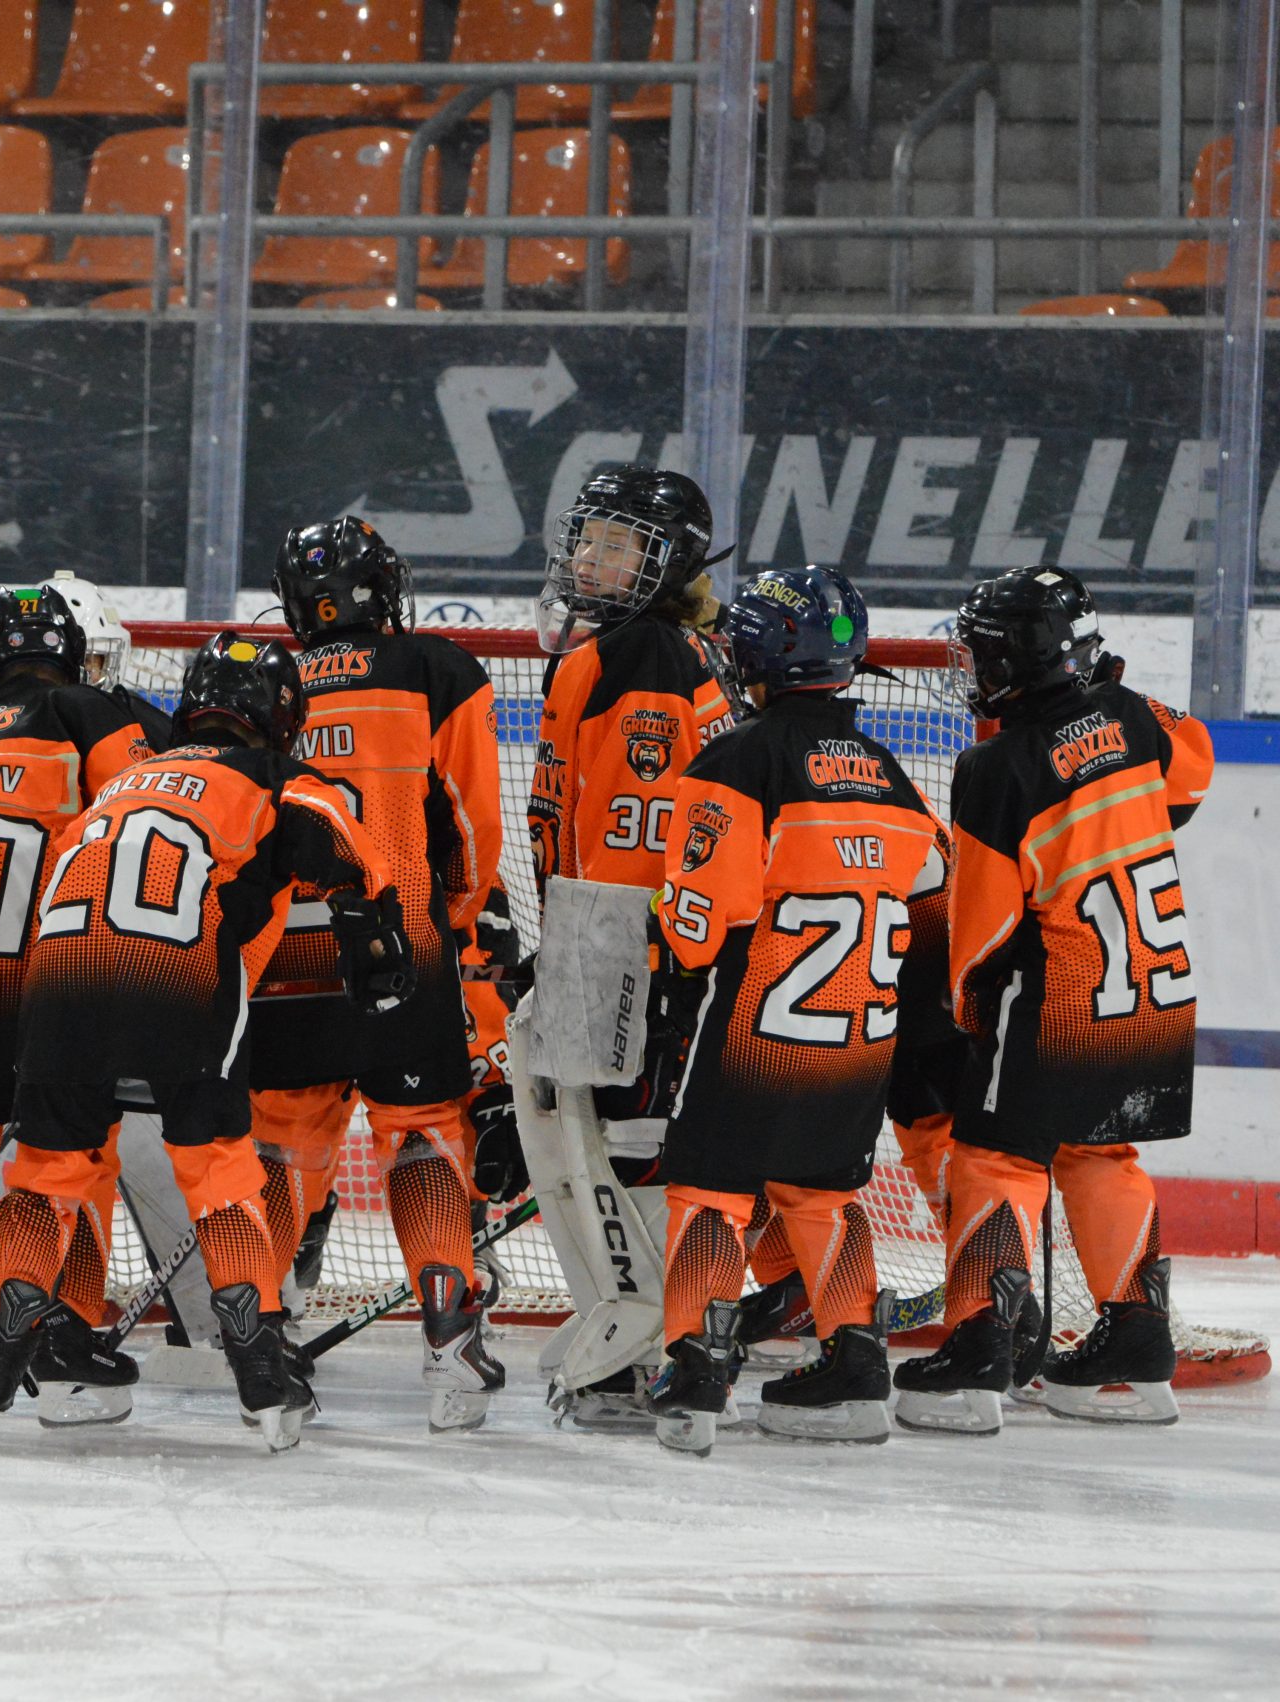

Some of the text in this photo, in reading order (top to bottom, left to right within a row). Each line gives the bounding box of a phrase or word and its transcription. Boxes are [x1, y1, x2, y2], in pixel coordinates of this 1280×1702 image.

[686, 523, 710, 542] BAUER
[20, 599, 38, 614] 27
[317, 598, 338, 622] 6
[750, 579, 810, 615] ZHENGDE
[742, 624, 760, 635] CCM
[973, 625, 1005, 638] BAUER
[622, 715, 680, 740] GRIZZLYS
[635, 709, 668, 722] YOUNG
[604, 793, 675, 853] 30
[36, 806, 217, 949] 20
[1078, 849, 1197, 1022] 15
[751, 890, 911, 1049] 25
[611, 973, 636, 1073] BAUER
[594, 1183, 639, 1293] CCM
